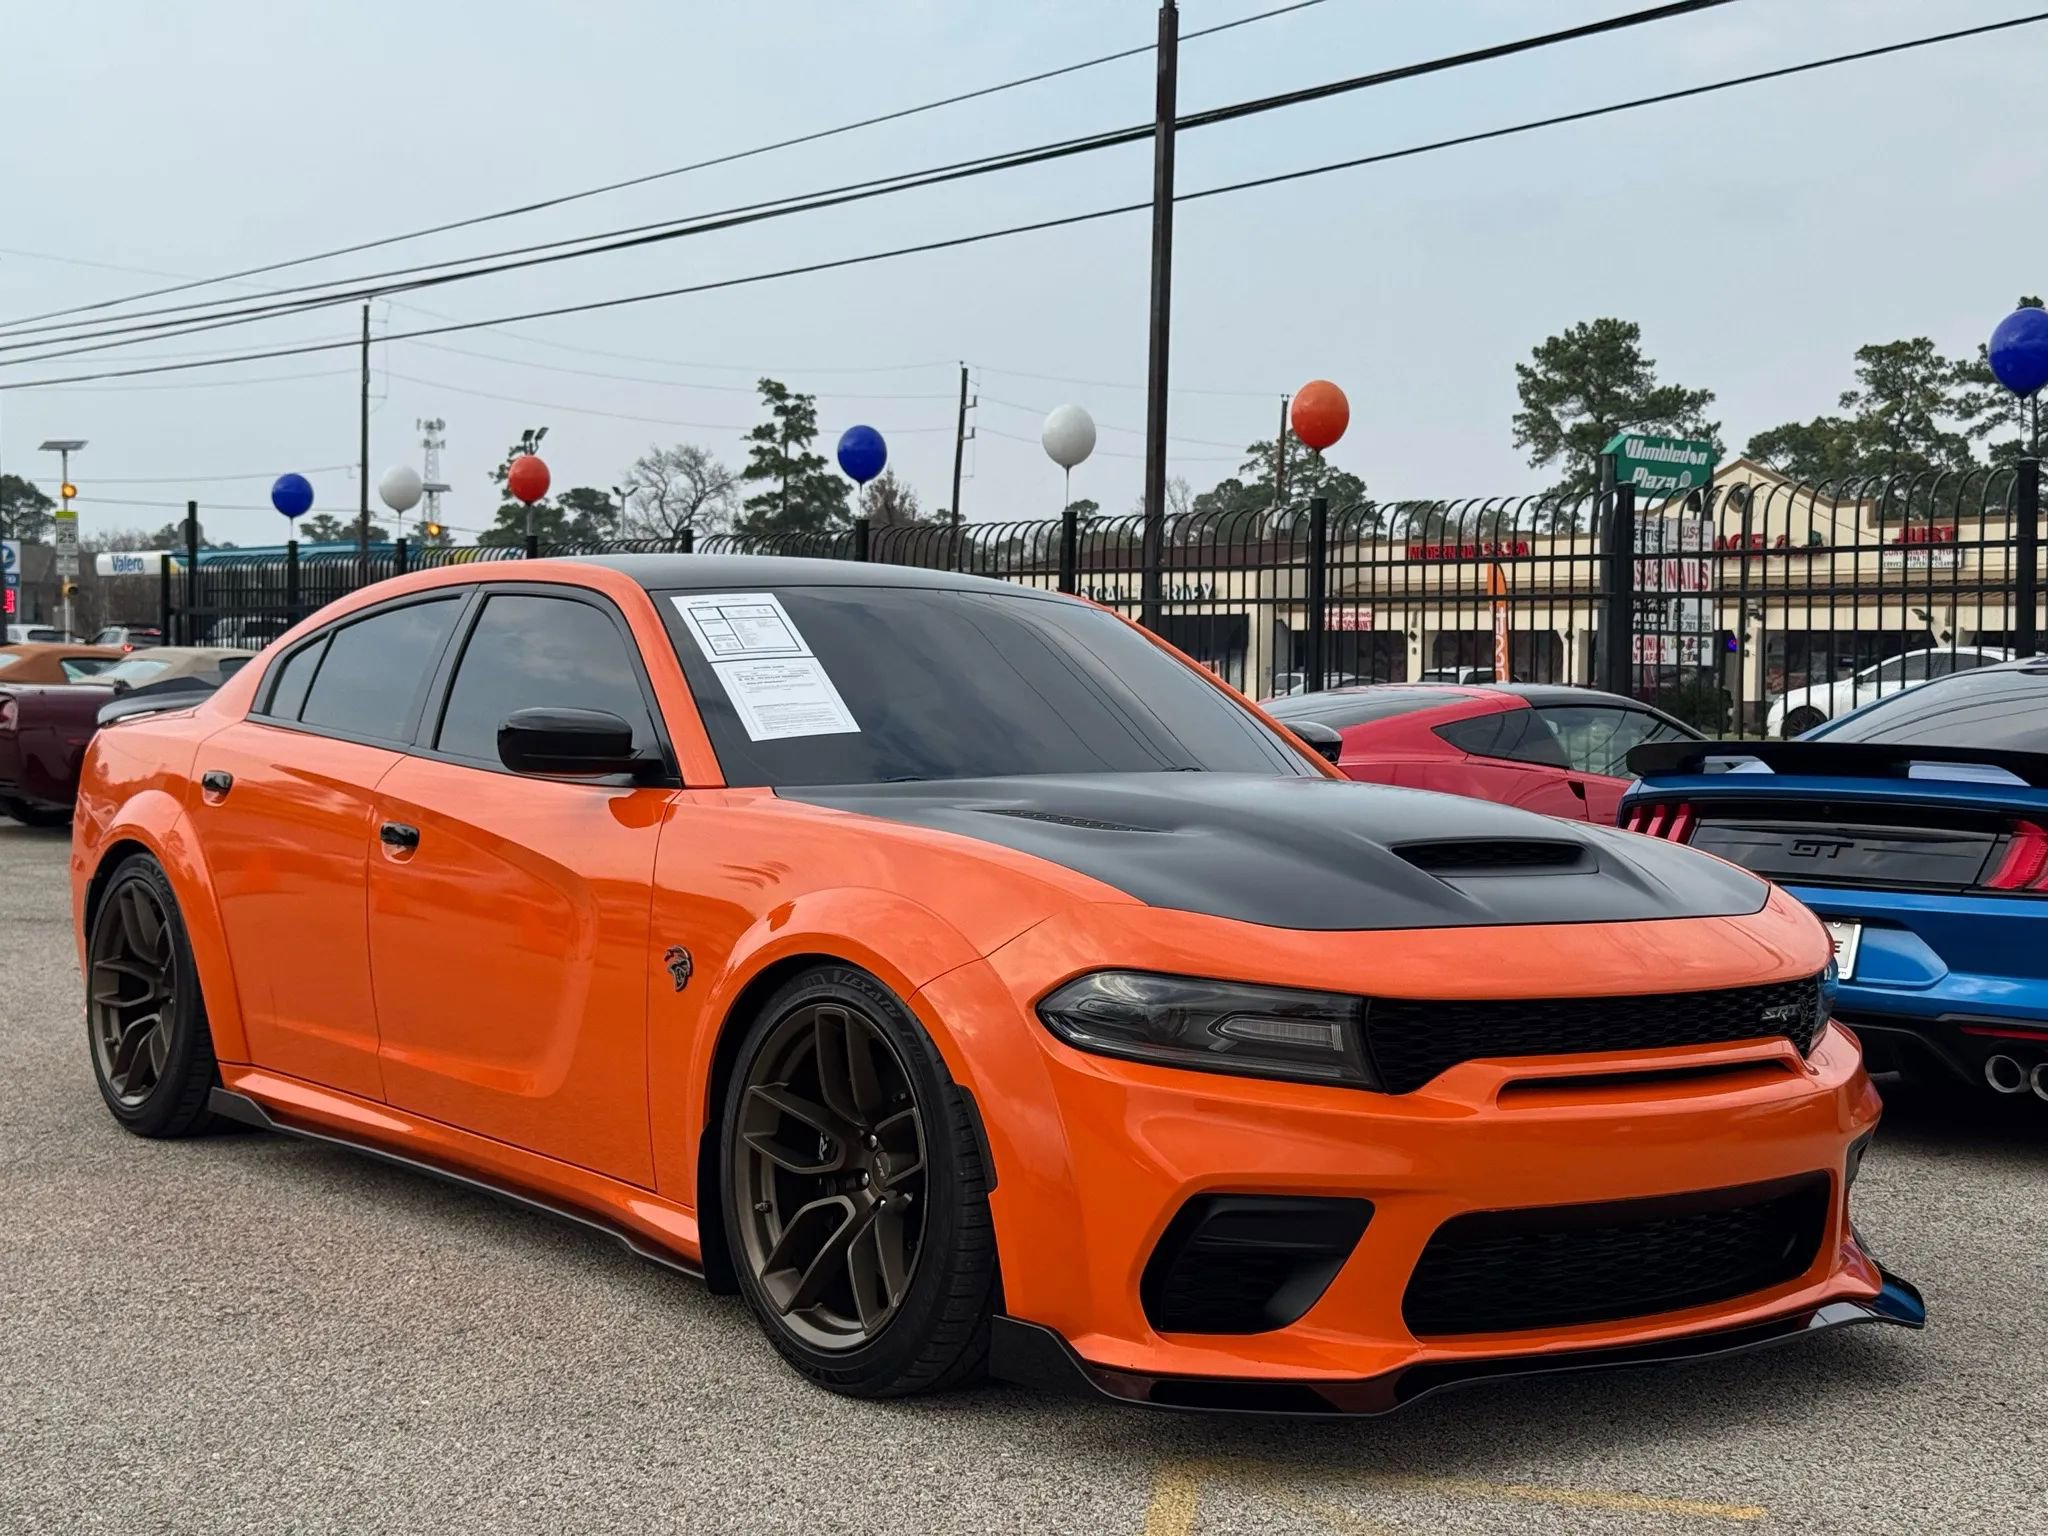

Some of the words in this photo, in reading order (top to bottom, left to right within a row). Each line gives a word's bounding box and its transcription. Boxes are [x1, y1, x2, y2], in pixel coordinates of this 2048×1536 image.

[1625, 438, 1708, 465] Wimbledon
[1631, 467, 1677, 491] Plaza
[111, 555, 144, 572] Valero
[1408, 545, 1456, 560] MDERN
[1667, 560, 1709, 591] NAILS
[1788, 839, 1854, 859] GT
